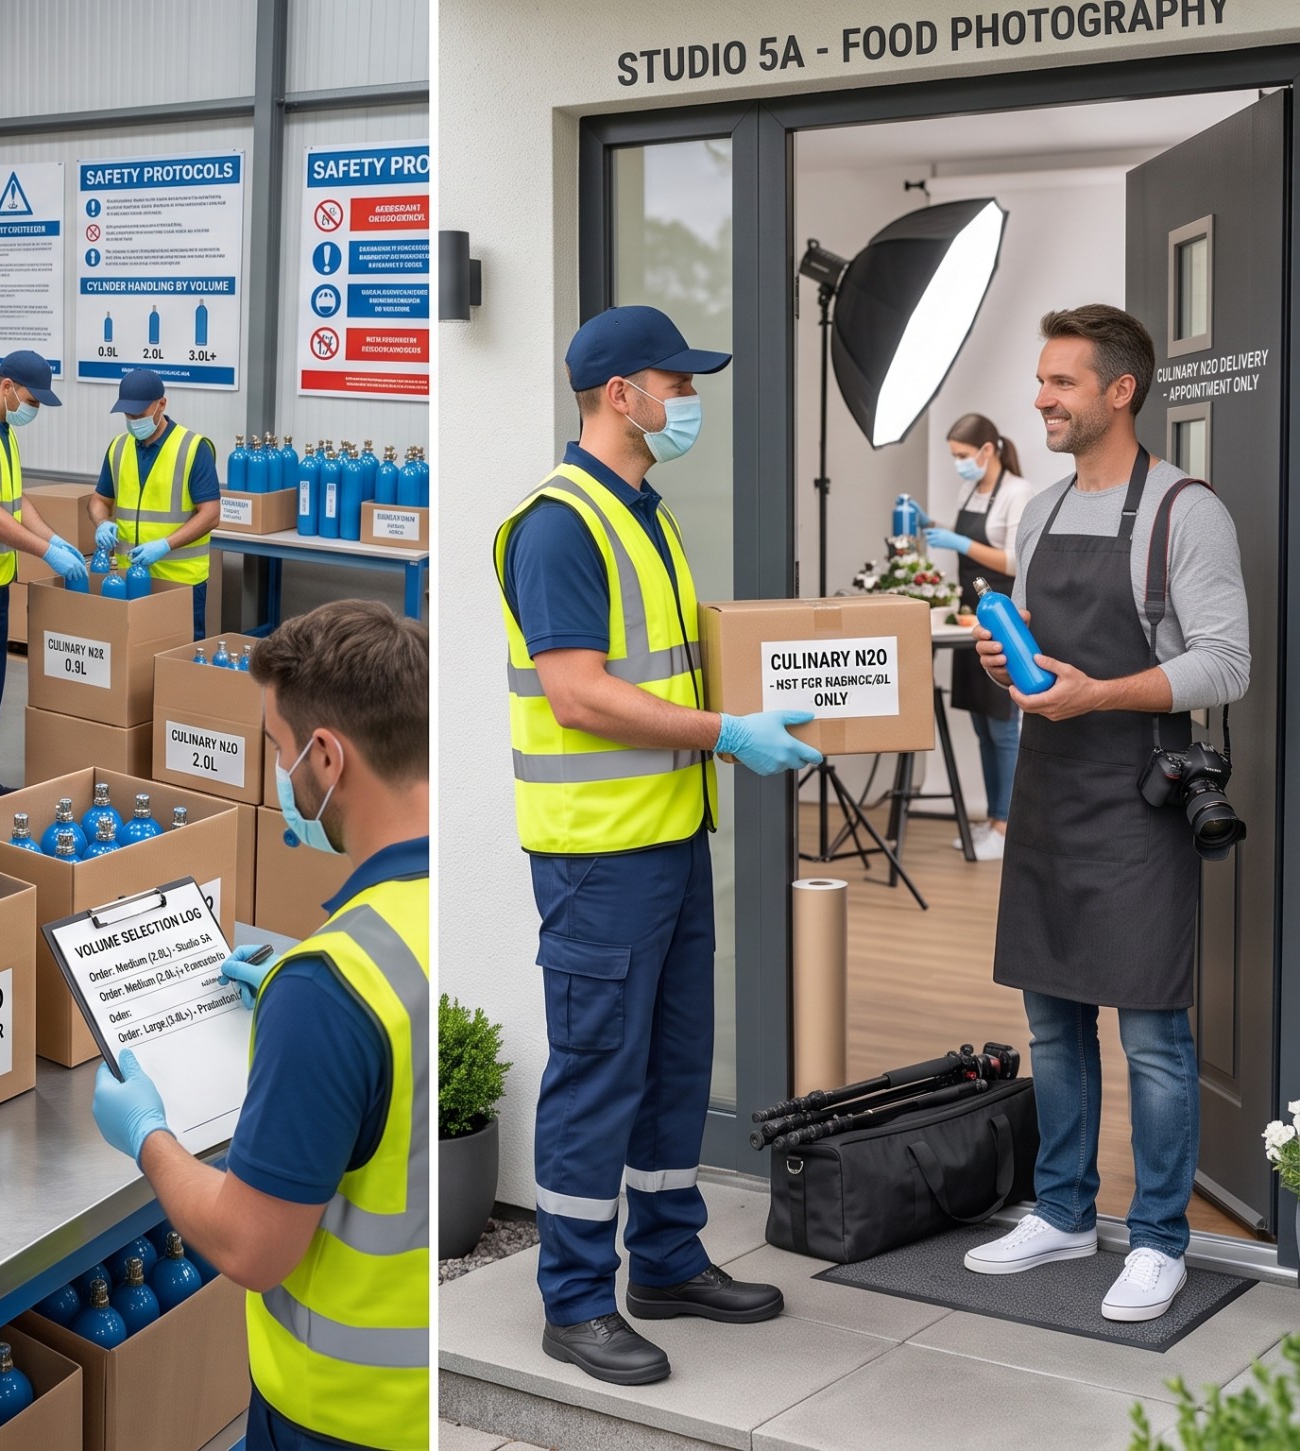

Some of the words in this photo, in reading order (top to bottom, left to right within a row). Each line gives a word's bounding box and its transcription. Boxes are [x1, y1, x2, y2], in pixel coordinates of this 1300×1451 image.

[617, 40, 747, 87] STUDIO
[758, 34, 805, 72] 5A
[842, 20, 938, 63] FOOD
[950, 0, 1227, 51] PHOTOGRAPHY
[86, 168, 141, 185] SAFETY
[143, 162, 233, 182] PROTOCOLS
[313, 157, 386, 179] SAFETY
[127, 281, 174, 292] HANDLING
[175, 281, 188, 291] BY
[189, 280, 229, 291] VOLUME
[98, 346, 118, 358] 0.9L
[142, 348, 164, 360] 2.0L
[188, 350, 217, 362] 3.0L+
[1157, 361, 1199, 383] CULINARY
[1200, 358, 1219, 376] N2O
[1220, 349, 1269, 373] DELIVERY
[1169, 378, 1232, 401] APPOINTMENT
[1233, 373, 1260, 393] ONLY
[65, 658, 87, 675] 0.9L
[770, 650, 851, 671] CULINARY
[855, 648, 888, 667] N2O
[814, 691, 849, 707] ONLY
[171, 729, 217, 750] CULINARY
[192, 752, 218, 772] 2.0L
[74, 934, 121, 959] VOLUME
[120, 916, 181, 943] SELECTION
[179, 907, 202, 924] LOG
